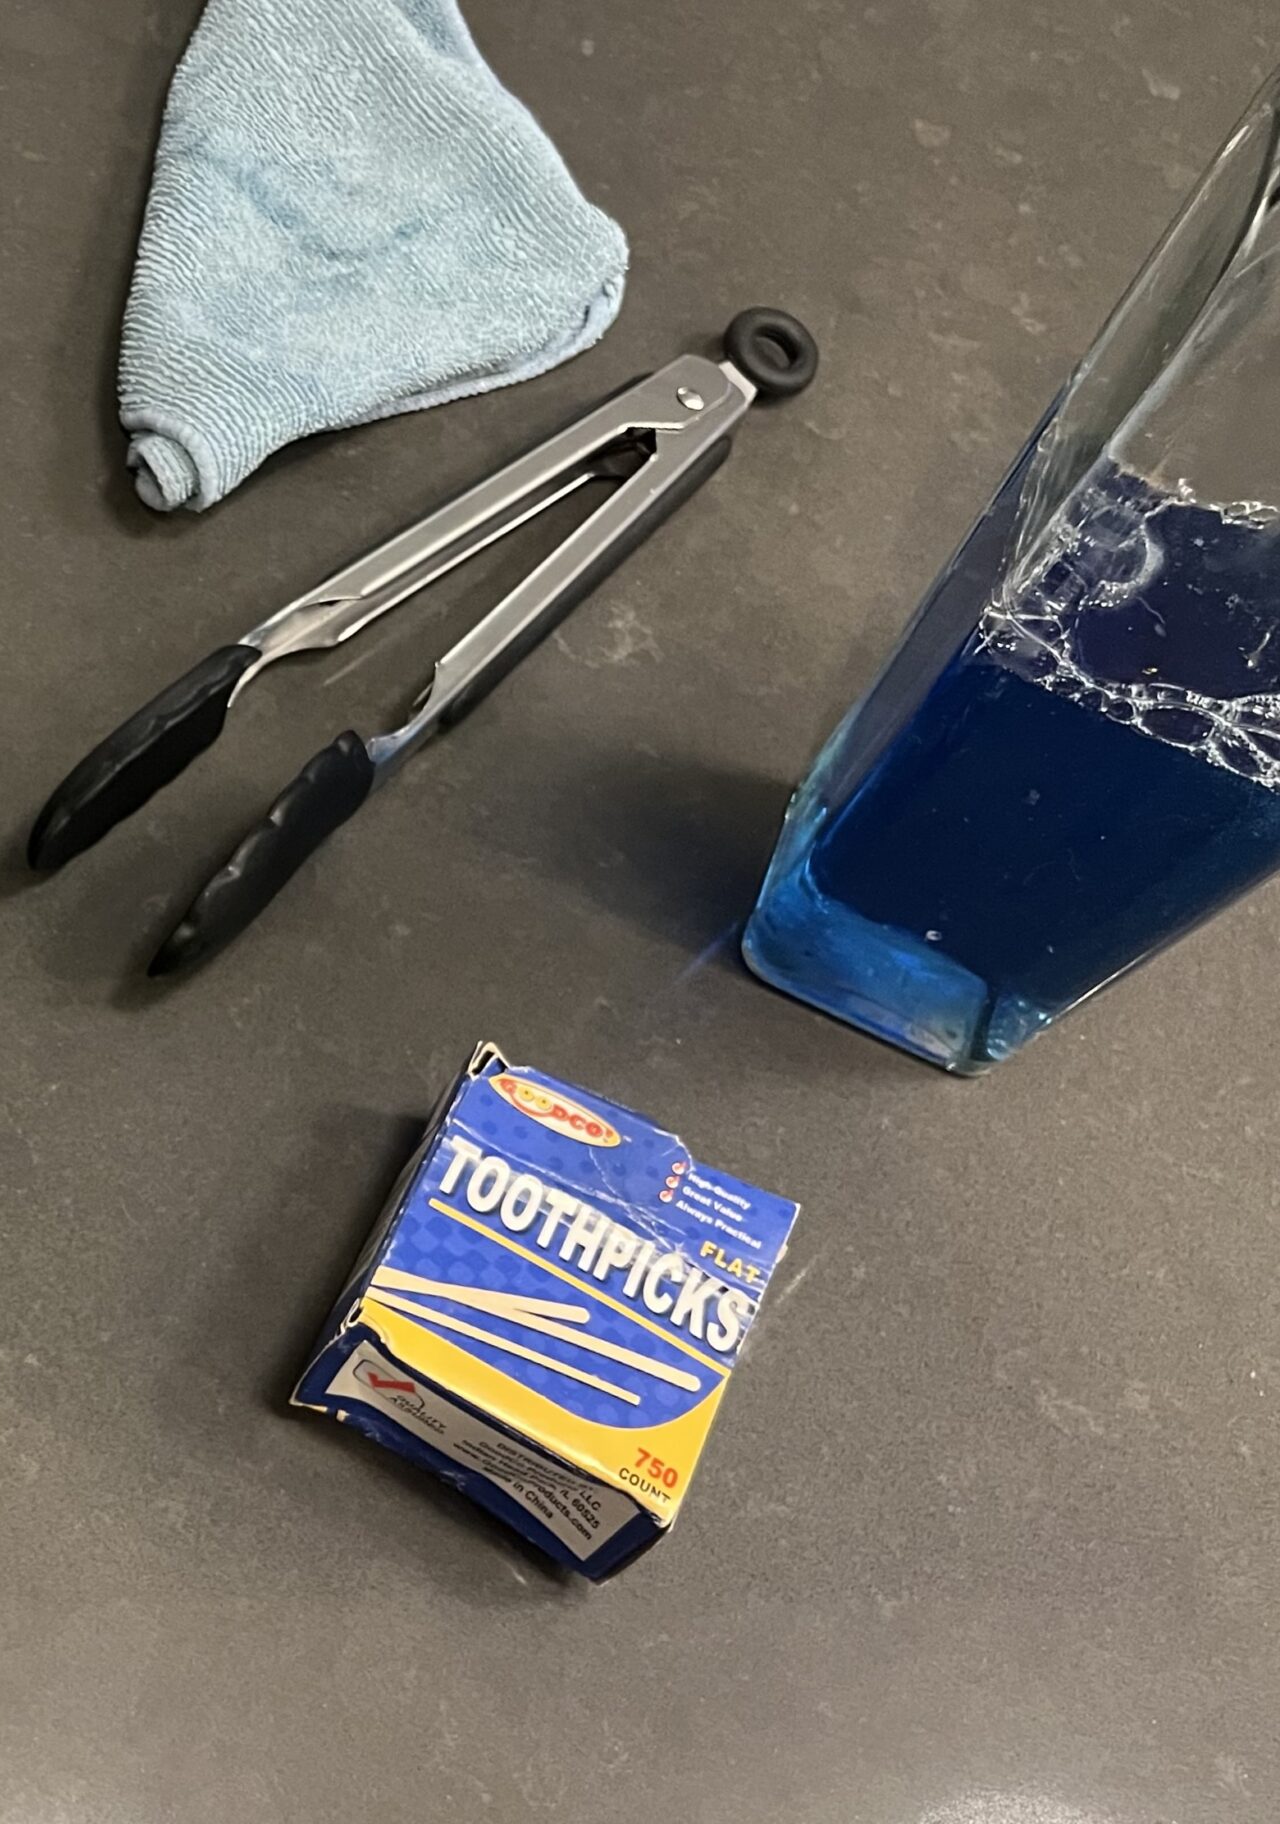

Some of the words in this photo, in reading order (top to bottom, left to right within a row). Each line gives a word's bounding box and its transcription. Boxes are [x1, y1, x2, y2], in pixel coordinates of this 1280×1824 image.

[675, 1199, 713, 1225] Always
[713, 1217, 763, 1250] Practical
[682, 1185, 713, 1208] Great
[713, 1200, 744, 1223] Value
[438, 1134, 754, 1353] TOOTHPICKS
[699, 1240, 762, 1284] FLAT
[618, 1467, 672, 1503] COUNT
[634, 1446, 679, 1489] 750
[512, 1480, 525, 1493] in
[524, 1489, 554, 1519] China
[579, 1488, 601, 1512] LLC
